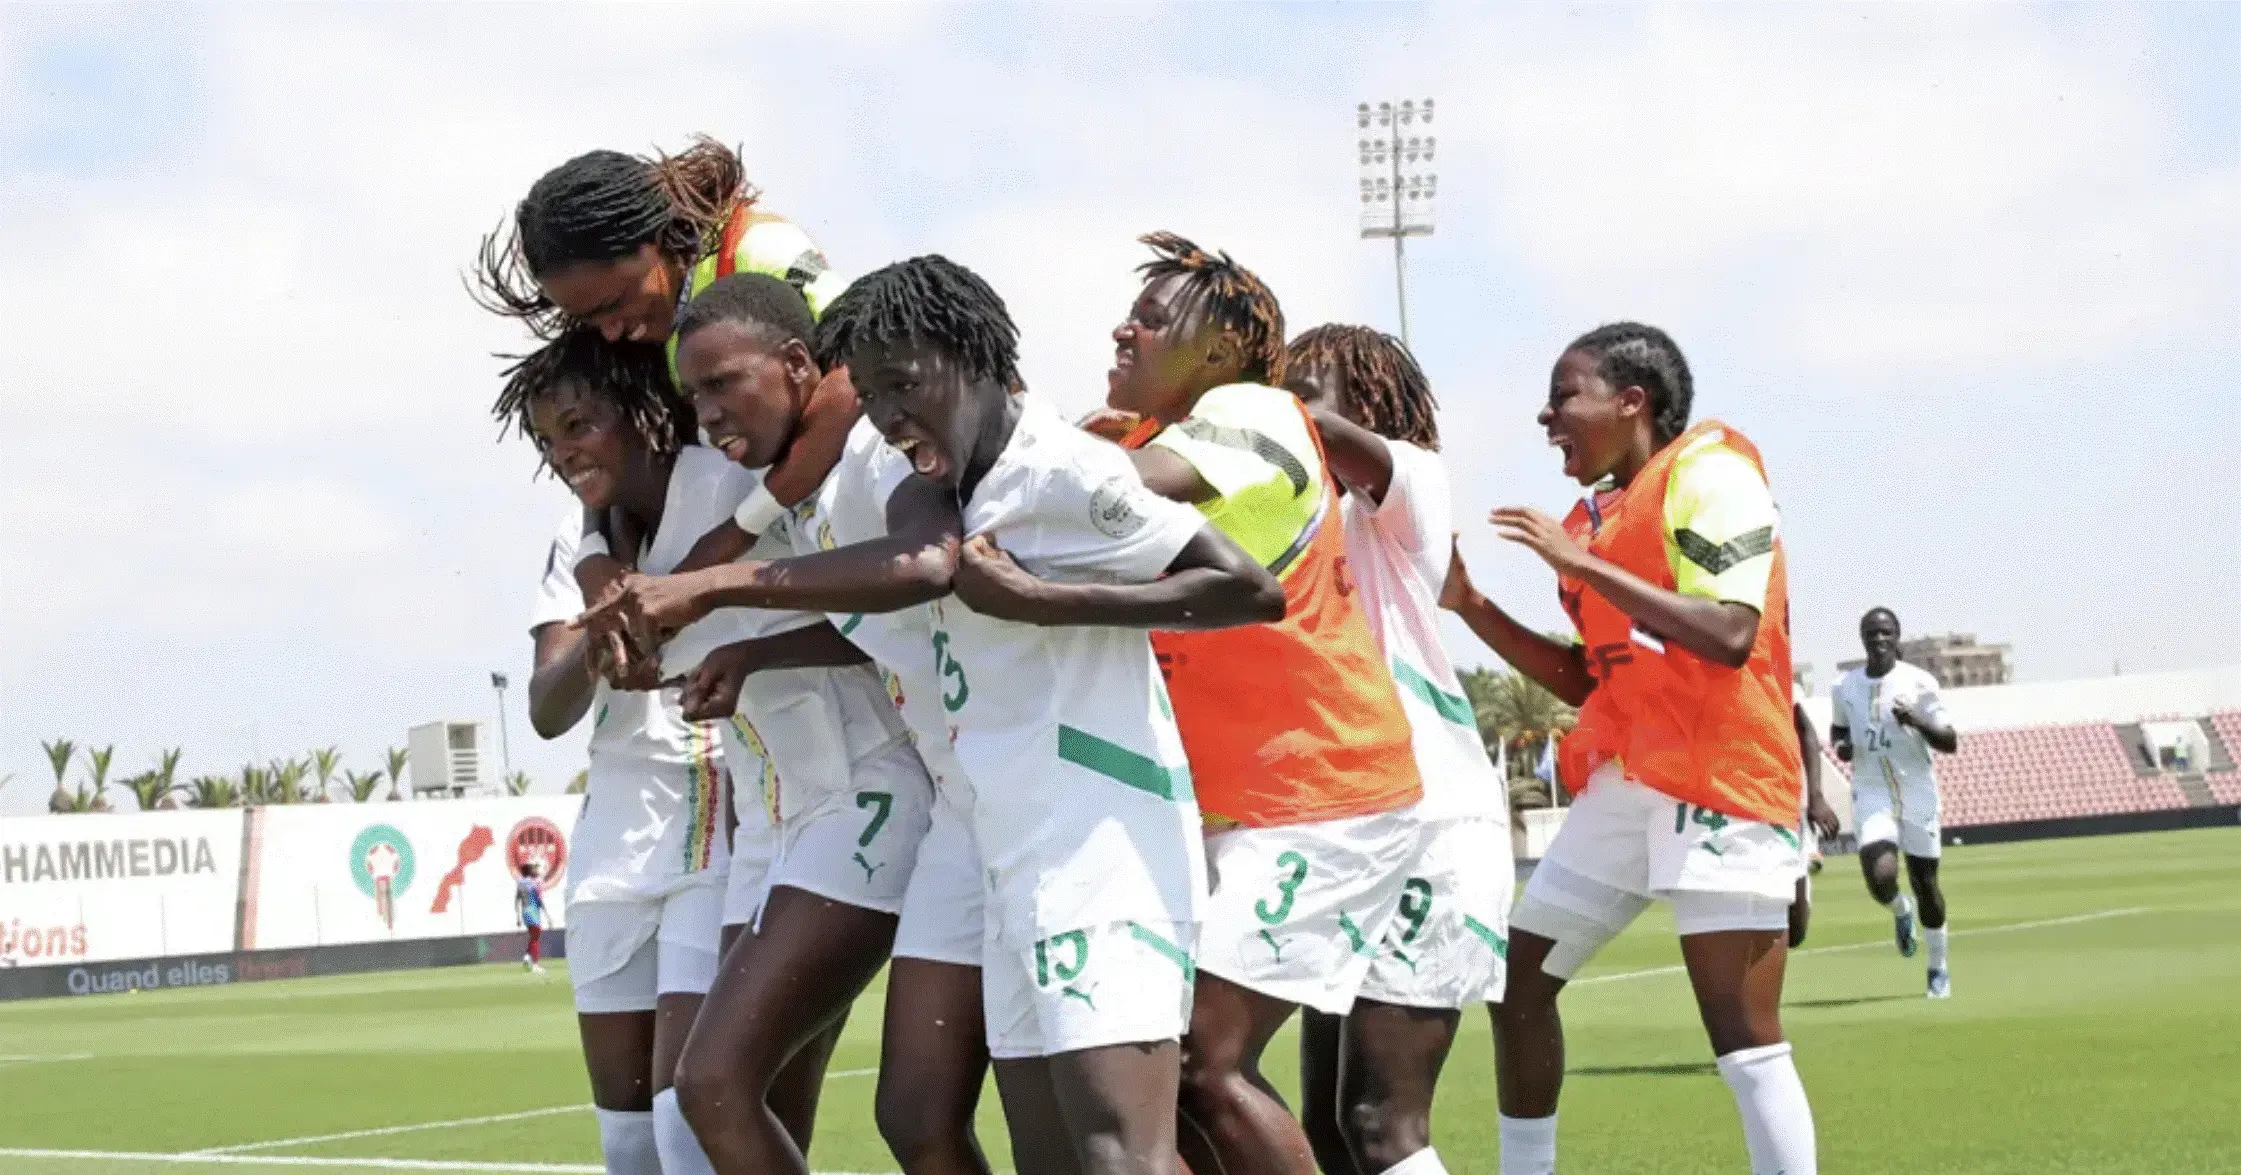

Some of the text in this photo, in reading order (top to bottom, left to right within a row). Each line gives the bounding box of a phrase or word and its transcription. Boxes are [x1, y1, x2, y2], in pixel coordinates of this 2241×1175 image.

[1864, 727, 1892, 752] 24
[856, 791, 893, 847] 7
[1254, 850, 1308, 924] 3
[1399, 877, 1432, 944] 9
[67, 965, 161, 995] Quand
[166, 961, 230, 985] elles
[1034, 928, 1089, 987] 15
